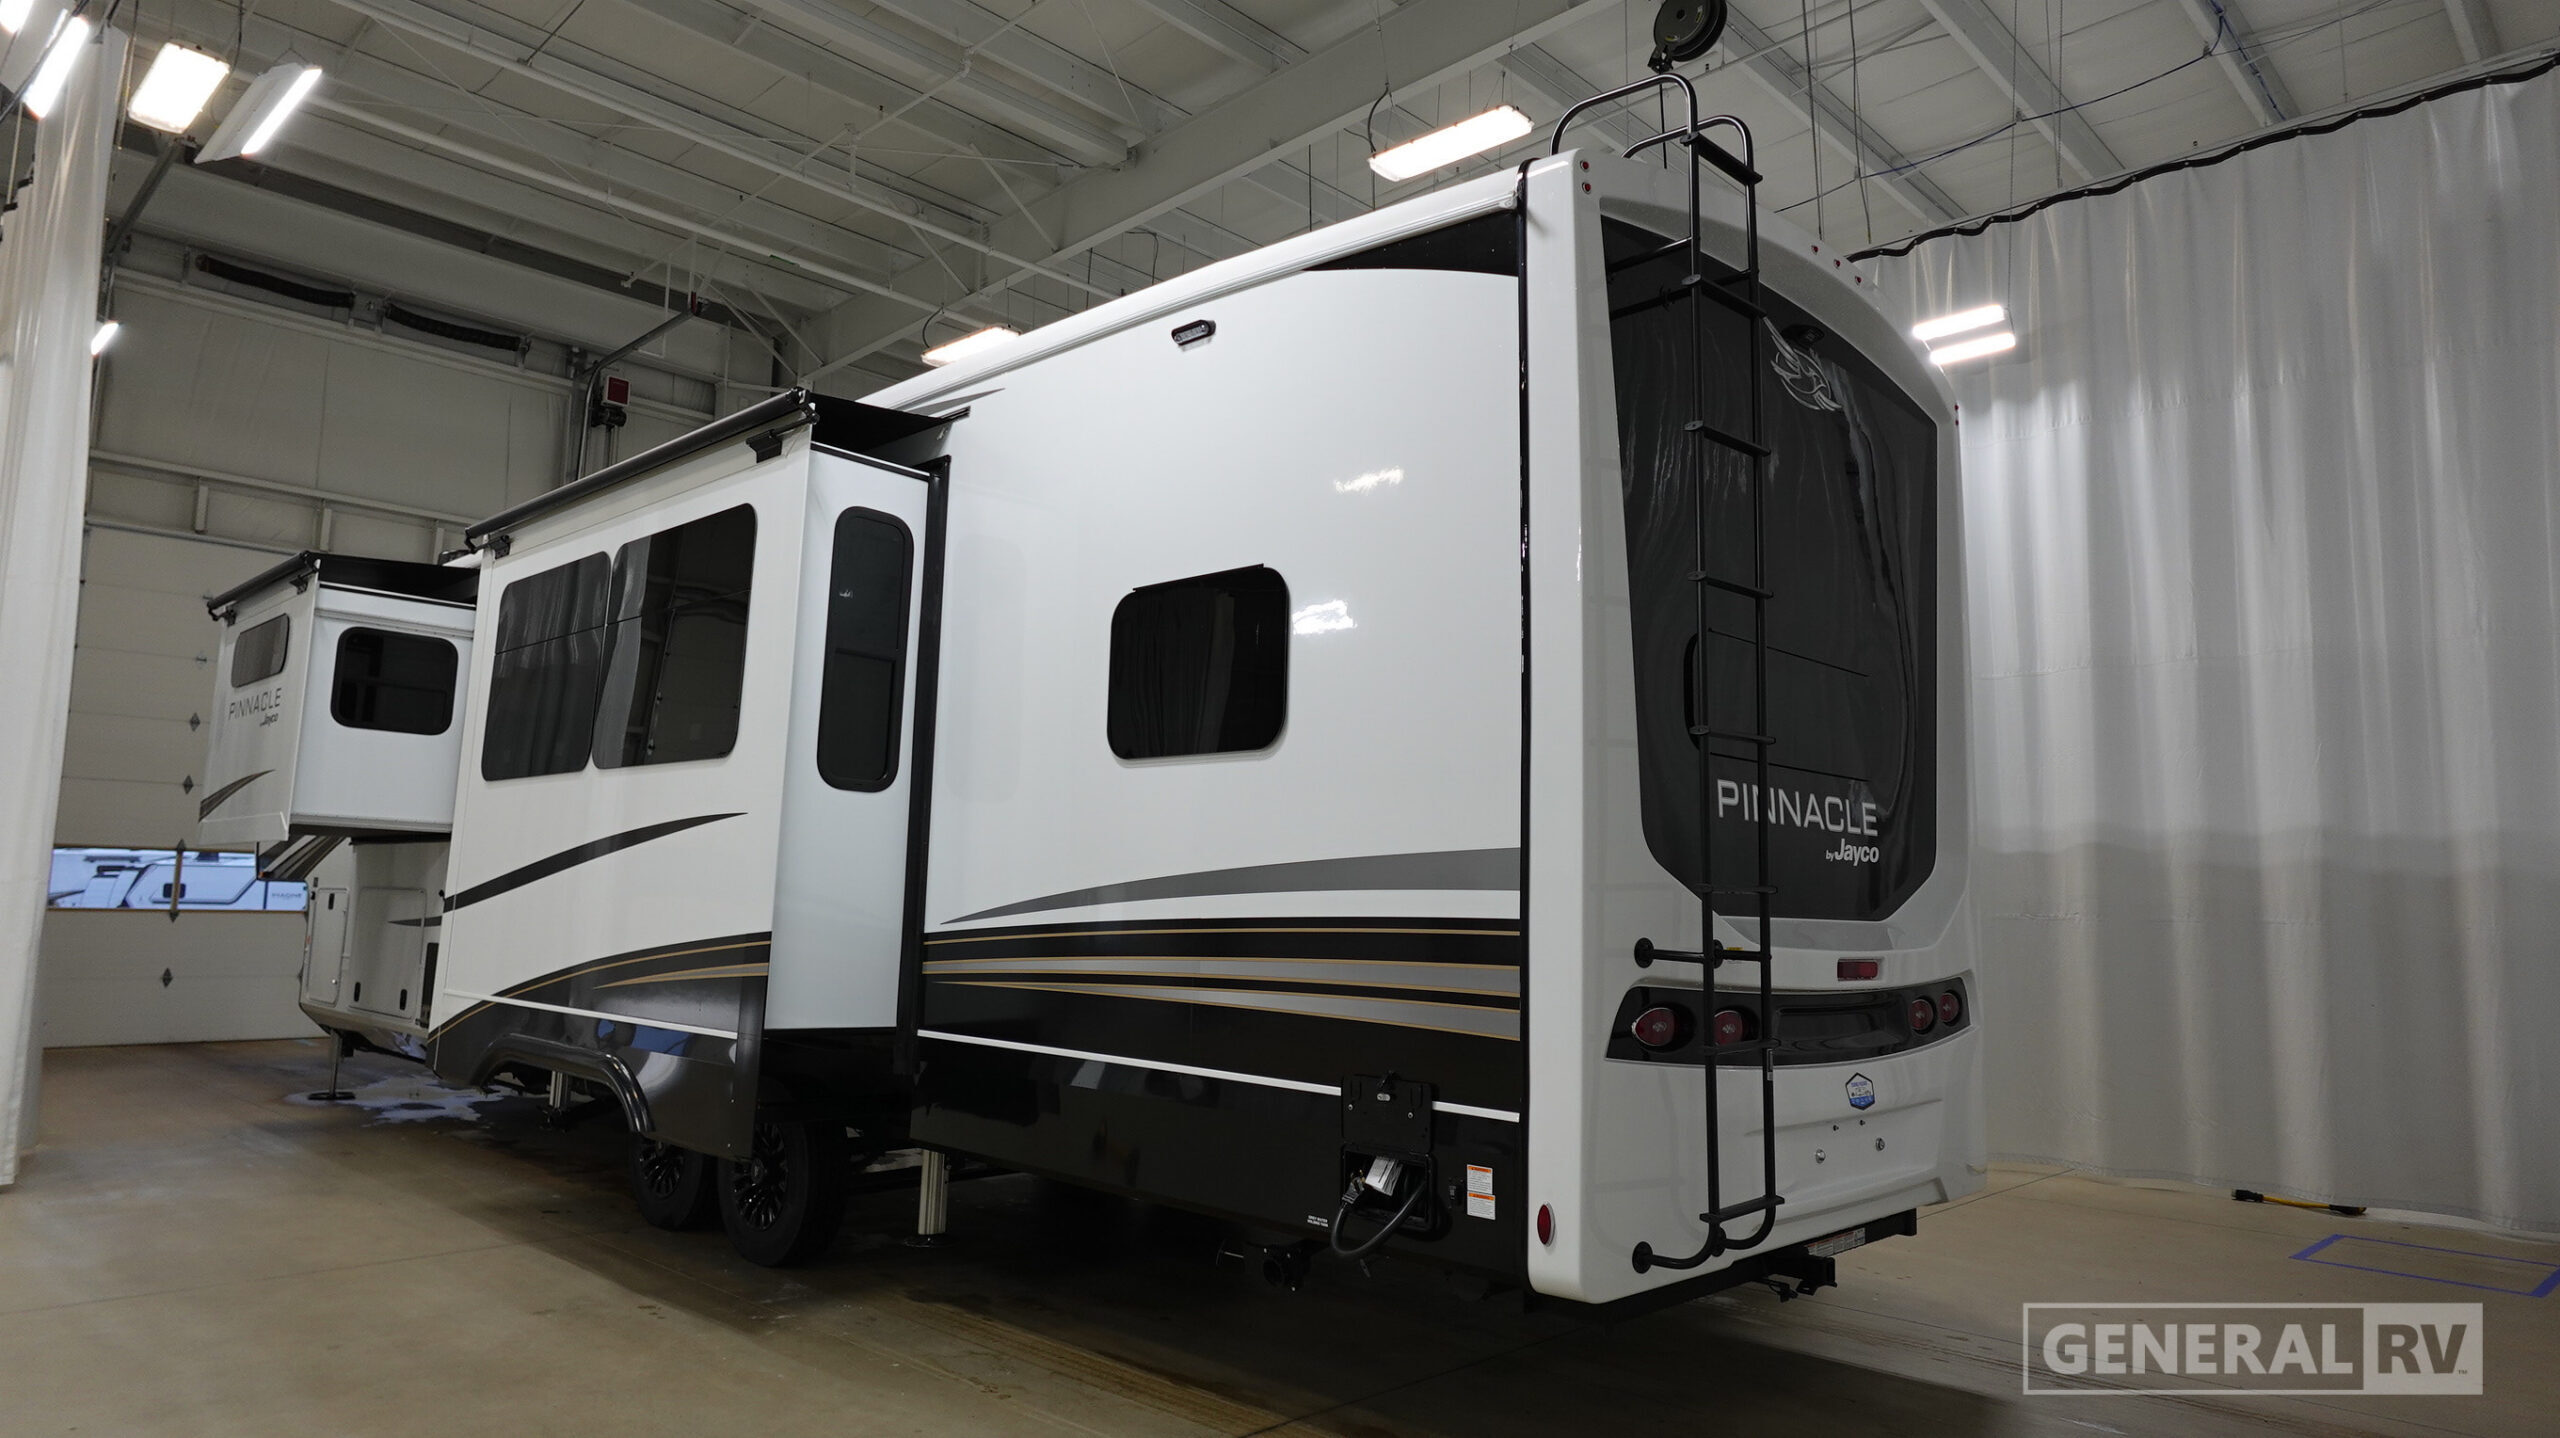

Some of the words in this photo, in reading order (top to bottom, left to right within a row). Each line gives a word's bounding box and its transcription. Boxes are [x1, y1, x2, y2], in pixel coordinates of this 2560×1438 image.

[229, 688, 281, 720] PINNACLE
[1717, 779, 1878, 837] PINNACLE
[1825, 849, 1834, 862] by
[1834, 838, 1880, 866] Jayco
